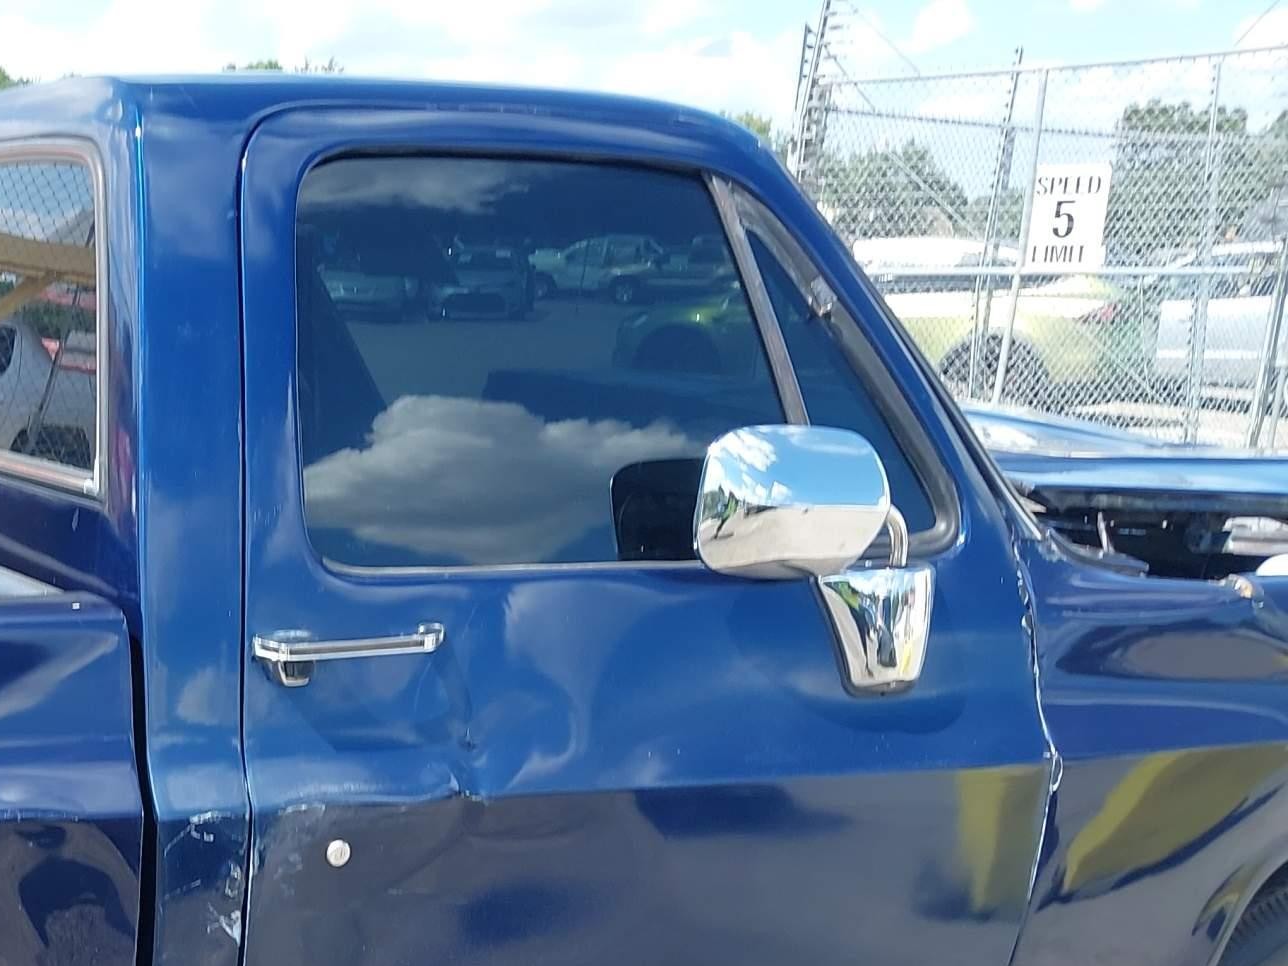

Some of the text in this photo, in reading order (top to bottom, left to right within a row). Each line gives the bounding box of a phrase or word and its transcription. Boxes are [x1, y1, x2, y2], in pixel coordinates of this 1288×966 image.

[1036, 176, 1102, 195] SPEED
[1052, 200, 1076, 238] 5
[1031, 245, 1084, 263] LIMIT
